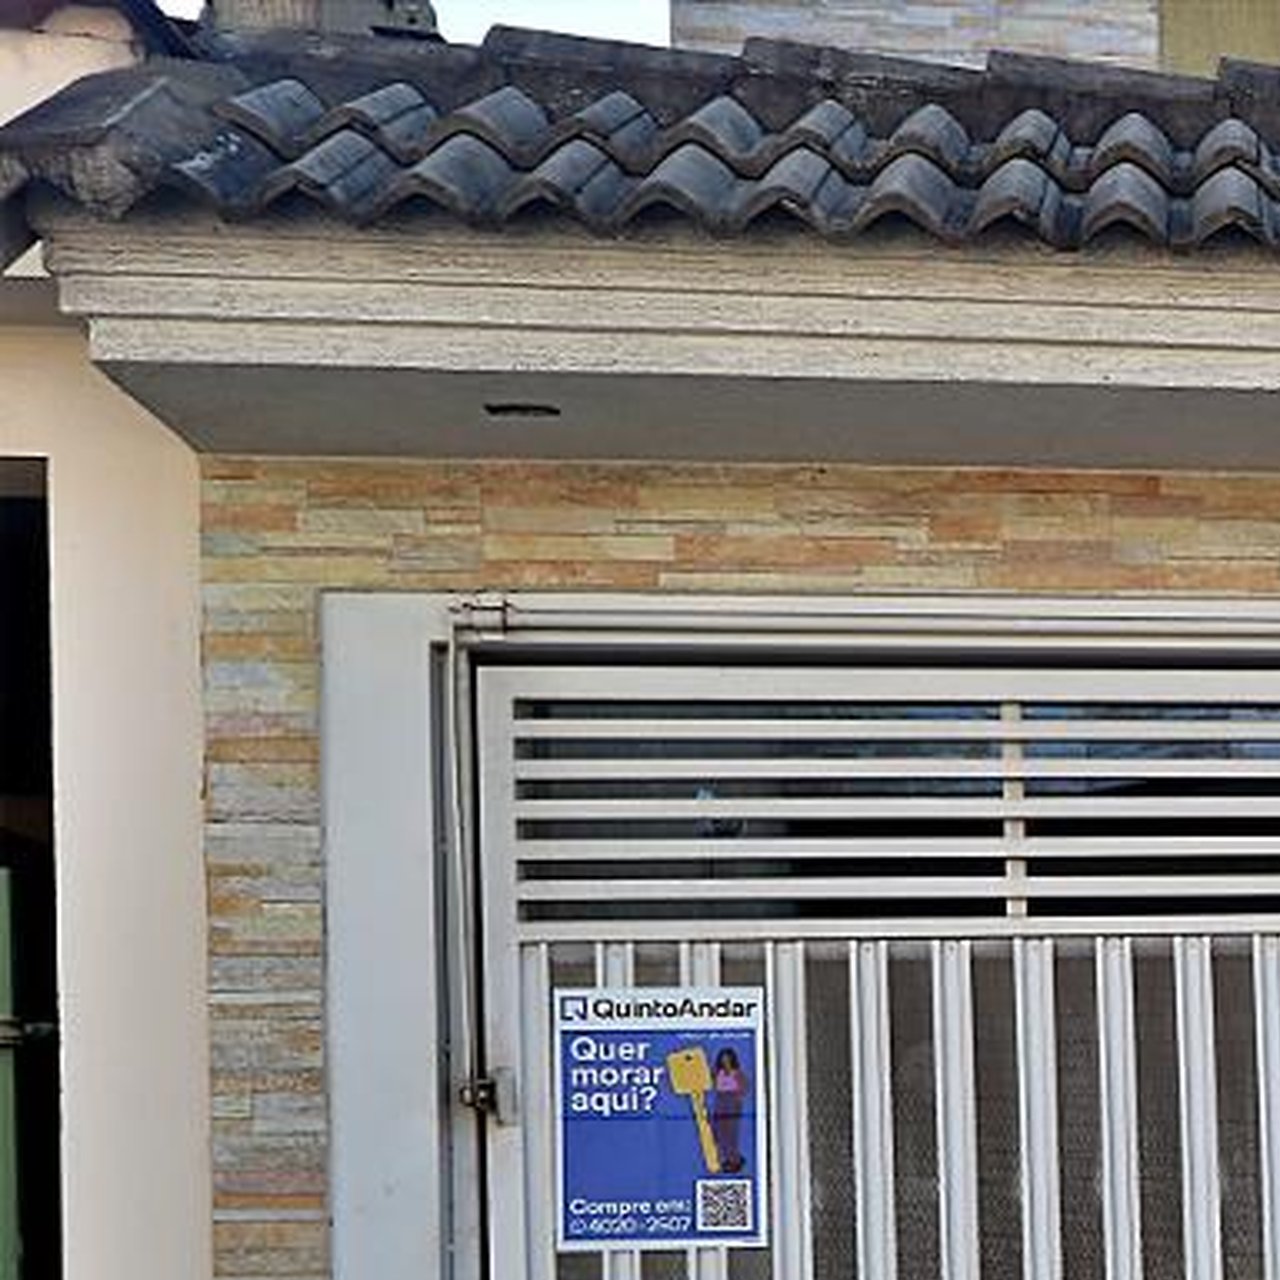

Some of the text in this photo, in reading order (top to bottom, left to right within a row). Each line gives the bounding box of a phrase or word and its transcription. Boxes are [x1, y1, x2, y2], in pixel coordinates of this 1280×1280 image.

[593, 999, 758, 1019] QuintoAndar
[571, 1036, 651, 1061] Quer
[572, 1066, 664, 1087] morar
[571, 1086, 658, 1117] aqui?
[569, 1199, 652, 1220] Compre
